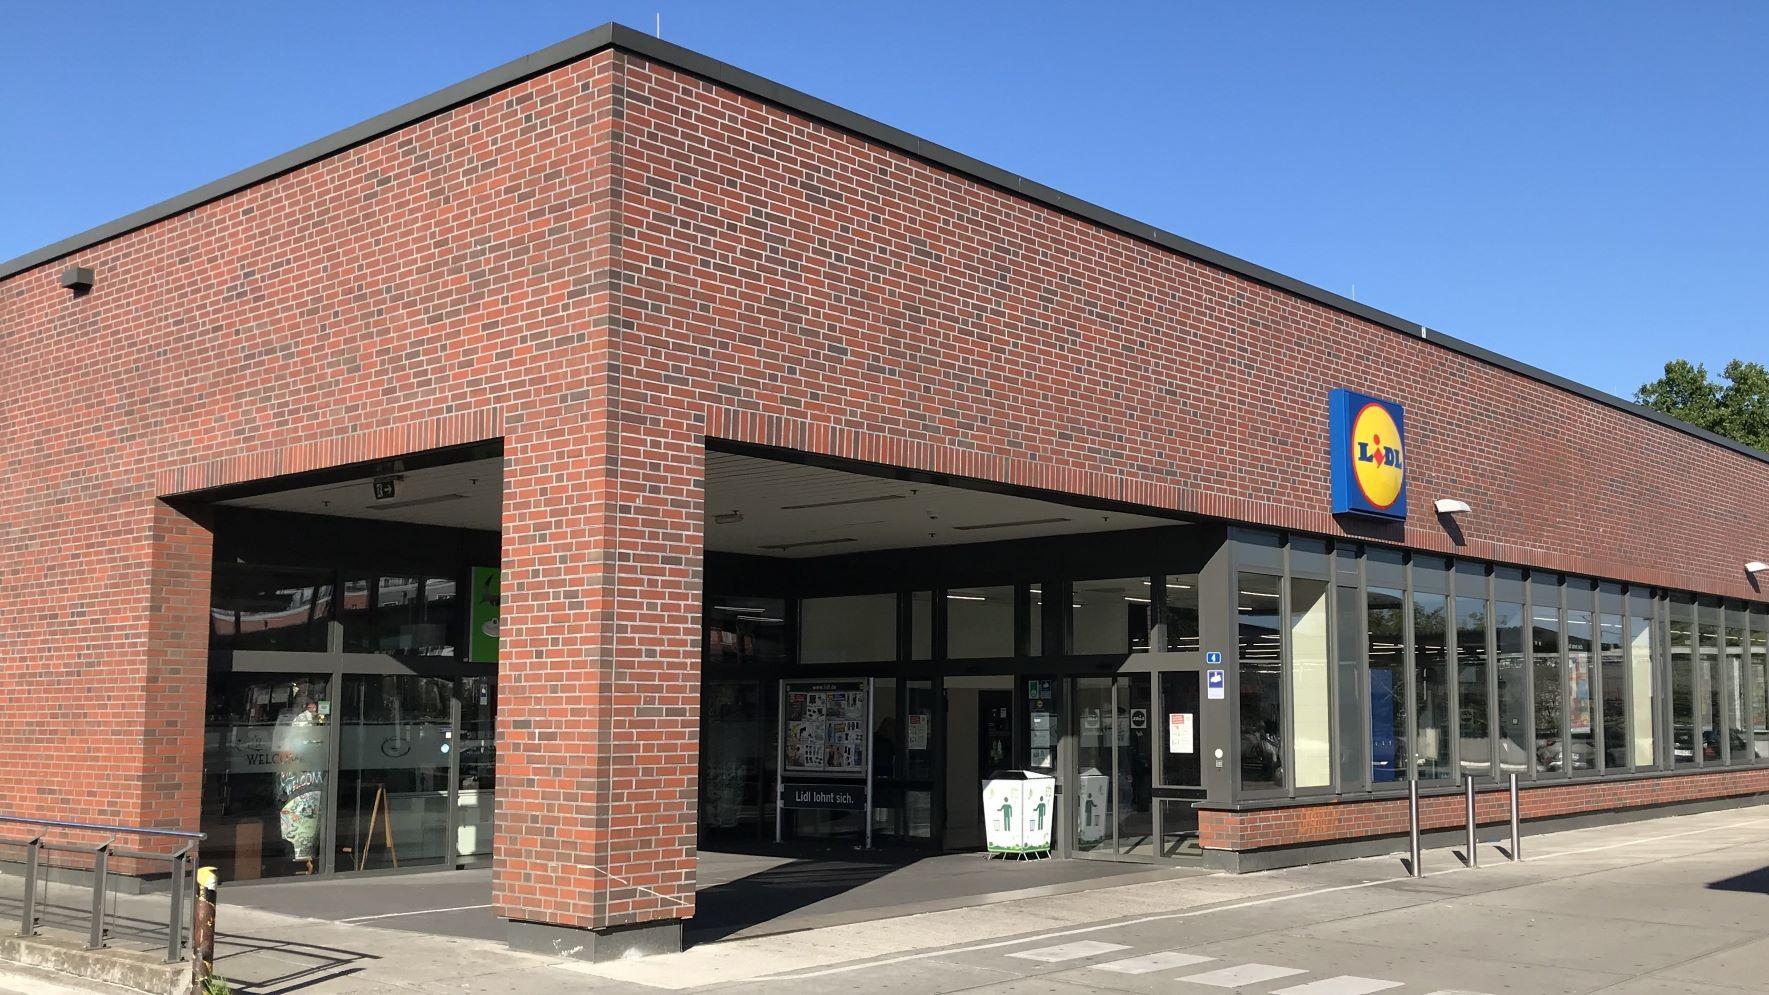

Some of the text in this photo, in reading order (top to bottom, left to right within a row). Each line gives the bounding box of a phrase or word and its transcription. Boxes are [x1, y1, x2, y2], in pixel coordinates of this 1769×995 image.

[286, 770, 323, 796] WELCOM
[795, 791, 854, 804] Lidl lohnt sich.
